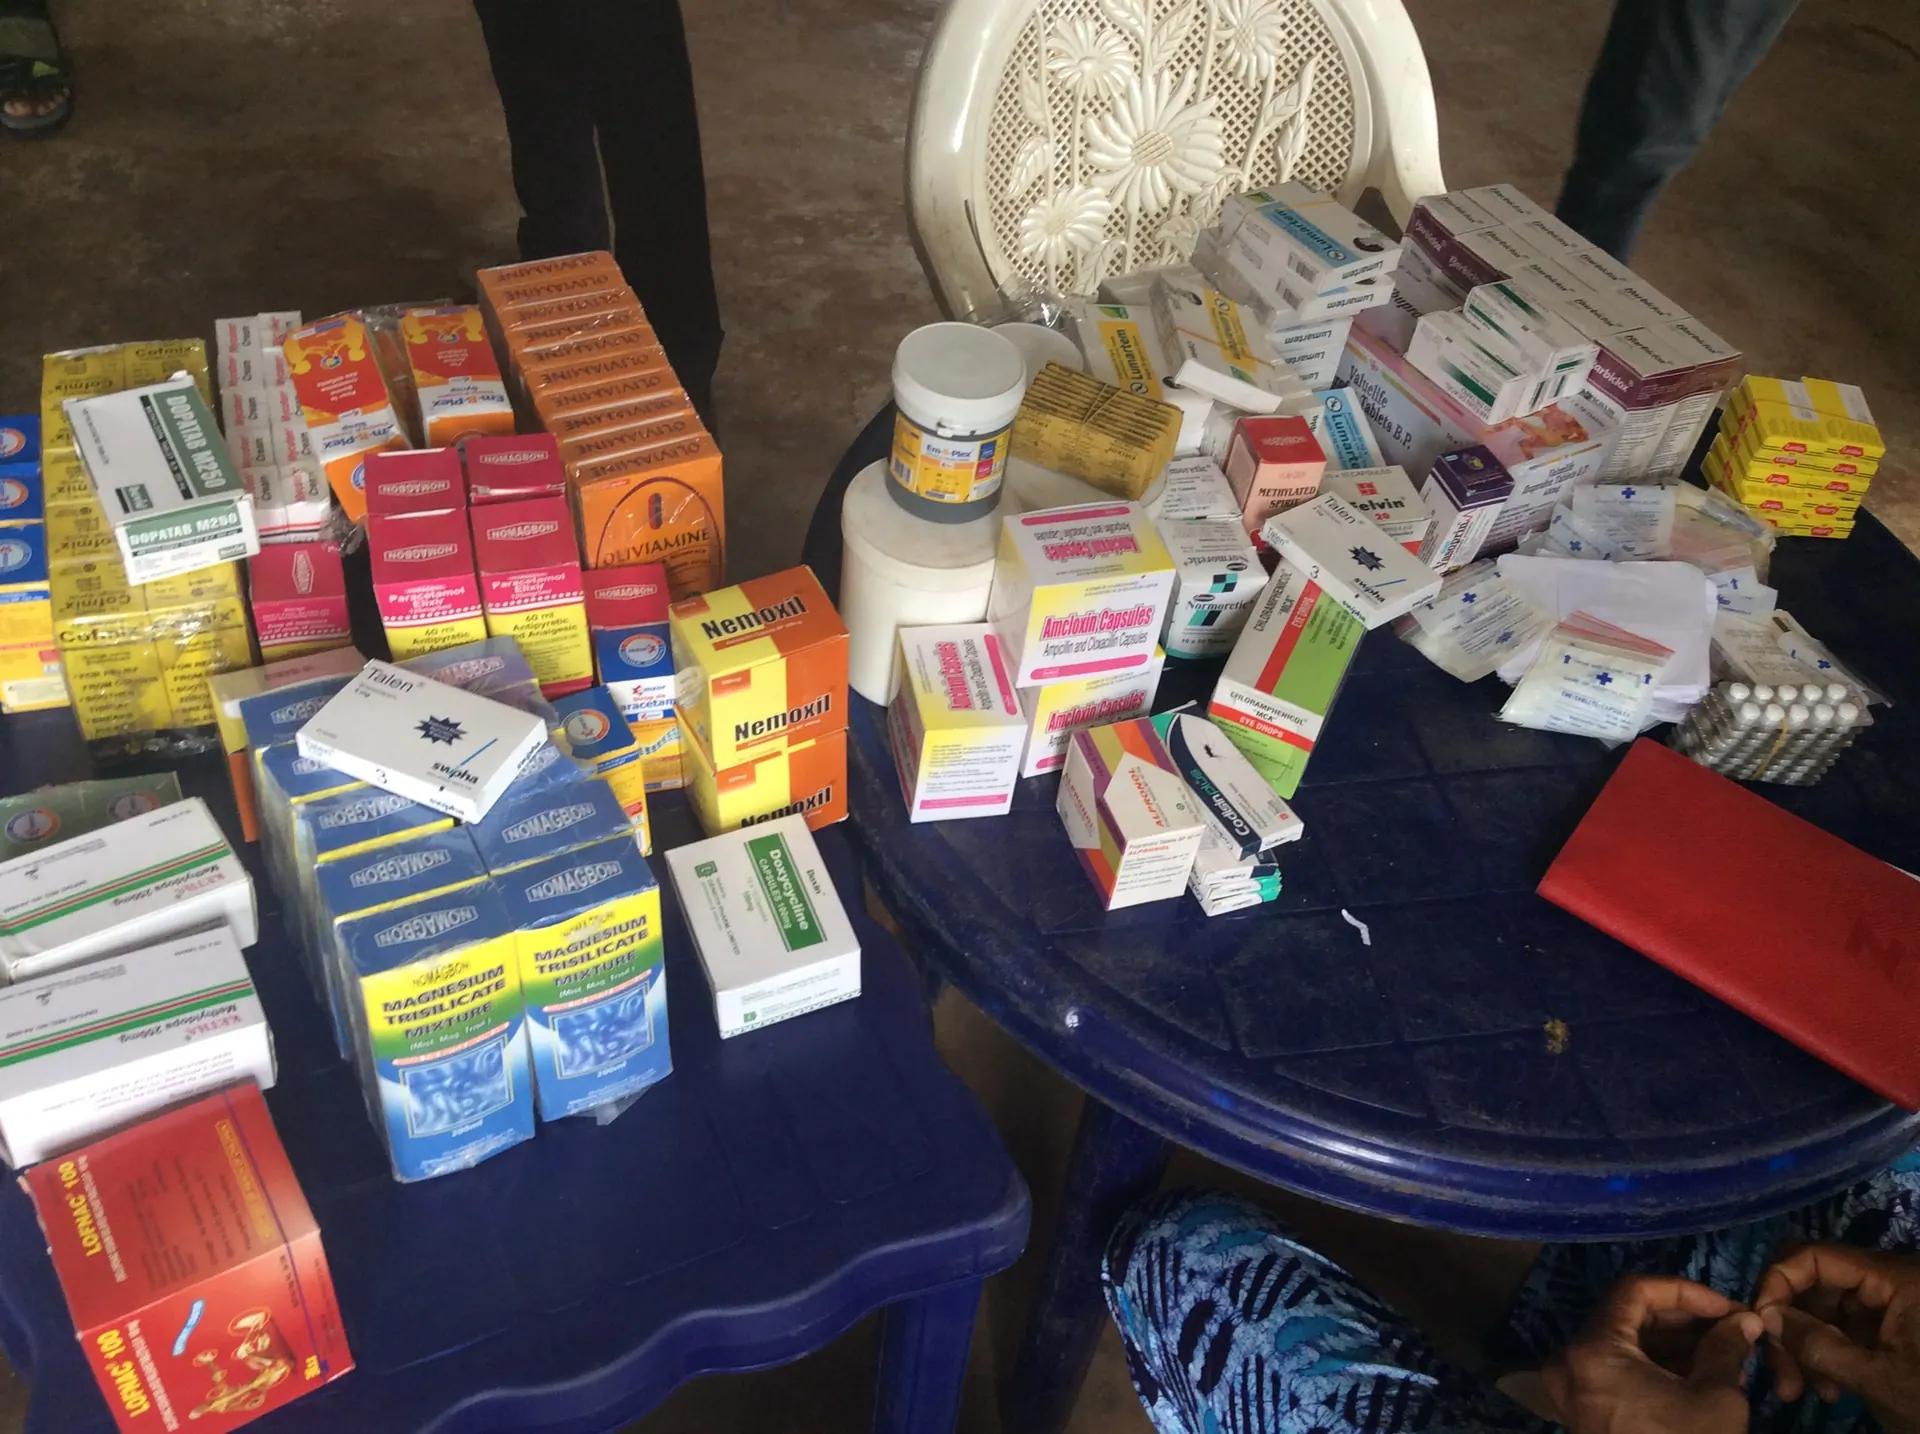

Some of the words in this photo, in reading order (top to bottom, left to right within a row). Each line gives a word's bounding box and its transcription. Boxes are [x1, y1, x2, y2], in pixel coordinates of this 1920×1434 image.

[497, 256, 598, 282] OLIVIAMINE
[507, 275, 608, 301] OLIVIAMINE
[1327, 293, 1374, 310] Lumartem
[1284, 330, 1332, 344] Lumartem
[541, 355, 649, 384] OLIVIAMINE
[1116, 329, 1143, 381] Lumartem
[554, 376, 661, 407] OLIVIAMINE
[1349, 364, 1388, 408] Valuelife
[1594, 363, 1630, 392] arbiclox
[578, 420, 685, 454] OLIVIAMINE
[1360, 395, 1392, 434] Tablets
[1394, 426, 1413, 450] B.P.
[167, 395, 208, 452] DOPATAB
[191, 450, 227, 490] M250
[591, 441, 700, 478] OLIVIAMINE
[1169, 464, 1212, 474] moretic
[1258, 486, 1317, 498] METHYLATED
[1325, 495, 1356, 525] Talon
[60, 538, 113, 552] ofmix
[129, 521, 192, 547] DOPATAB
[196, 512, 239, 533] M250
[603, 528, 712, 566] OLIVIAMINE
[1184, 555, 1250, 567] Normoretic
[388, 587, 465, 604] Paracetamol
[492, 574, 566, 590] Paracetamol
[1186, 598, 1248, 611] Normoretic
[1253, 570, 1293, 632] CHLORAMPHENICOL
[513, 618, 569, 632] Antipyretic
[527, 625, 578, 638] Analgesic
[701, 596, 808, 642] Nemoxil
[1041, 612, 1099, 641] Amcloxin
[1099, 605, 1153, 633] Capsules
[1043, 639, 1074, 657] Ampicillin
[1075, 638, 1087, 652] and
[1087, 634, 1118, 650] Cloxacillin
[1119, 631, 1148, 647] Capsules
[366, 666, 415, 694] Talon
[621, 698, 677, 711] aracetam
[735, 694, 831, 743] Nemoxil
[1047, 704, 1097, 732] Amcloxin
[1097, 689, 1145, 718] Capsules
[1240, 715, 1256, 731] EYE
[1257, 721, 1284, 739] DROPS
[430, 761, 479, 784] swpha
[1128, 768, 1164, 829] ALPRONOL
[507, 803, 593, 842] NOMAGBON
[355, 852, 448, 886] NOMAGBON
[531, 861, 620, 900] NOMAGBON
[759, 859, 781, 902] CAPSULES
[807, 869, 823, 896] Doxin
[769, 849, 809, 931] Doxycycline
[379, 907, 475, 947] NOMAGBON
[535, 914, 648, 963] MAGNESIUM
[536, 930, 649, 975] TRISILICATE
[555, 951, 637, 986] MIXTURE
[383, 964, 505, 1012] MAGNESIUM
[383, 978, 506, 1026] TRISILICATE
[405, 1002, 492, 1039] MIXTURE
[57, 1160, 80, 1189] 100
[69, 1195, 102, 1257] LOFNAC
[97, 1329, 126, 1360] 100
[111, 1361, 151, 1418] LOFNAC
